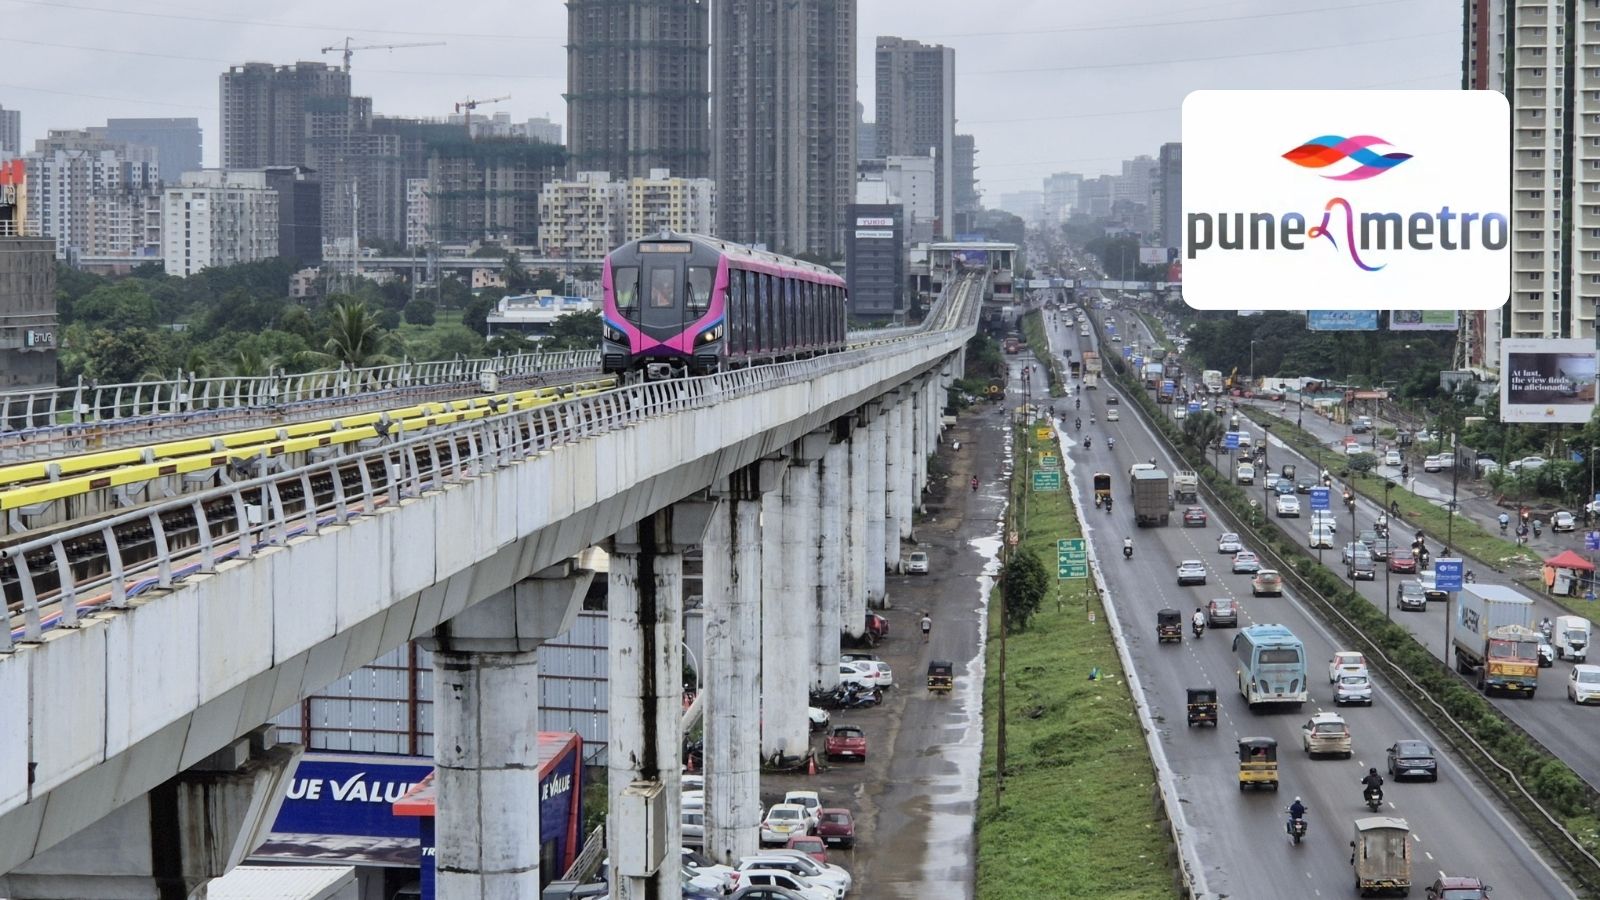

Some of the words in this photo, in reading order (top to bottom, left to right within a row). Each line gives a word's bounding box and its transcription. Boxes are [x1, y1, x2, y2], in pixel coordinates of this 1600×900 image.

[1548, 376, 1569, 384] finds
[286, 778, 323, 800] UE
[550, 772, 570, 798] VALUE
